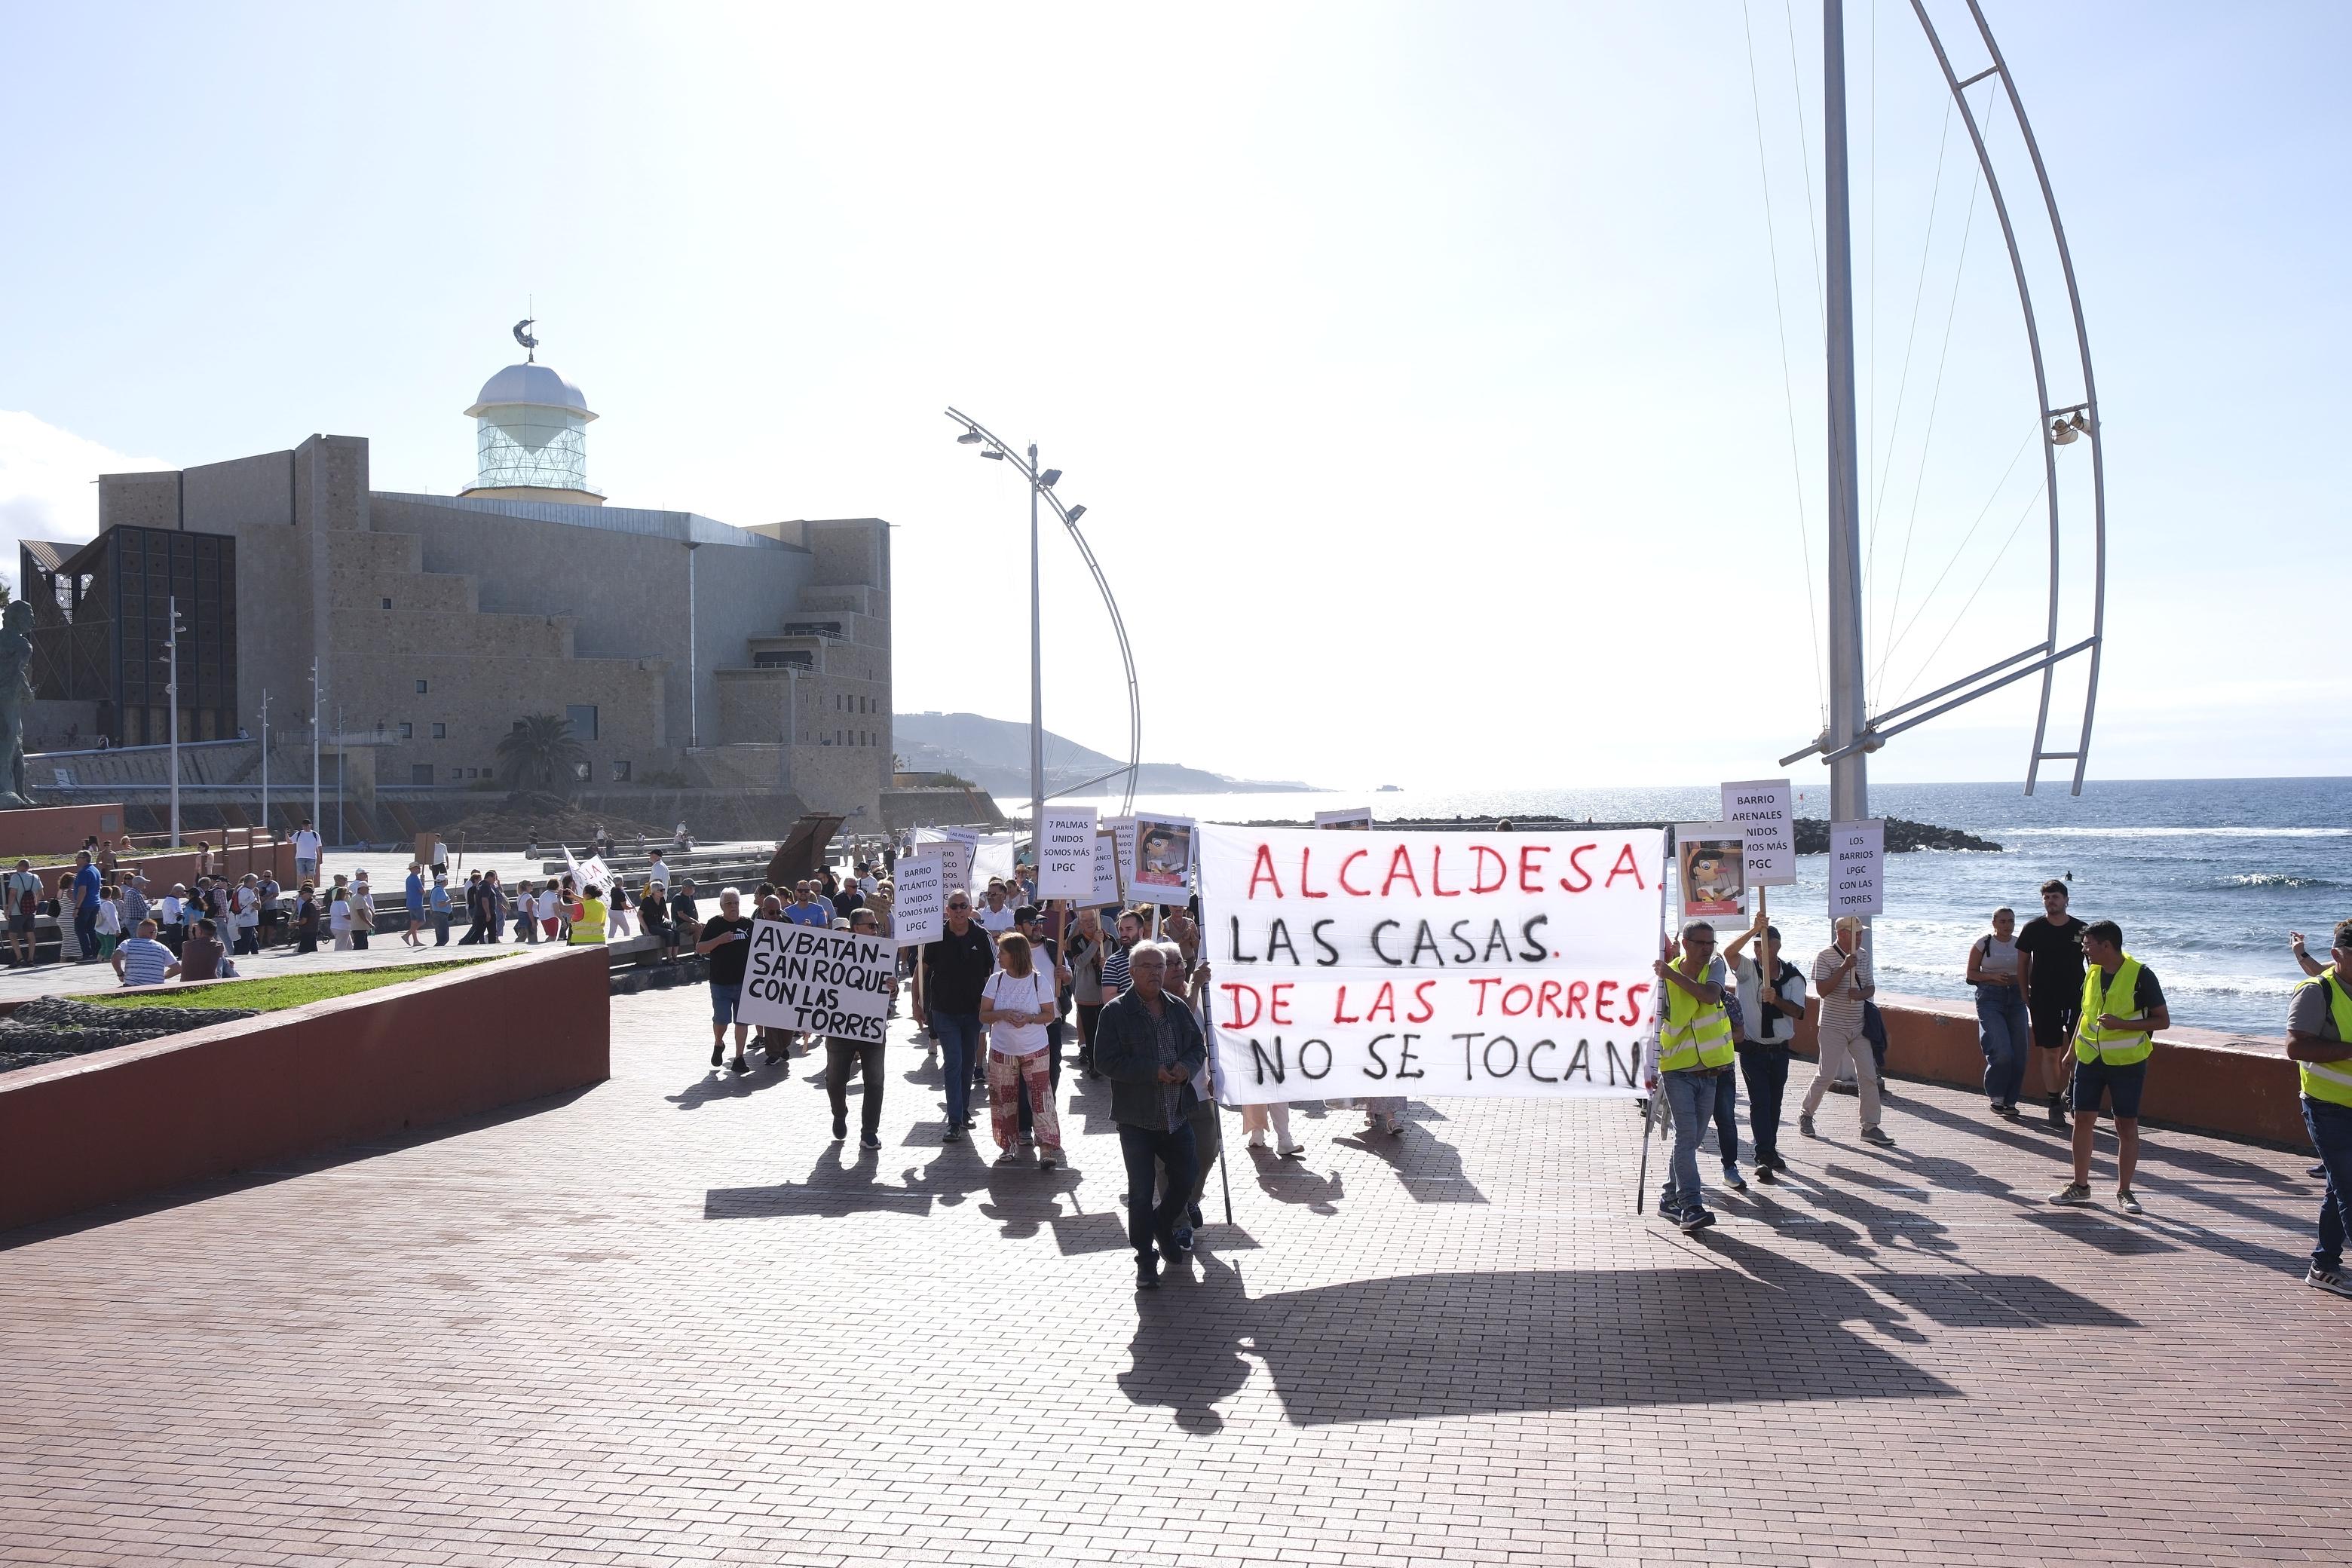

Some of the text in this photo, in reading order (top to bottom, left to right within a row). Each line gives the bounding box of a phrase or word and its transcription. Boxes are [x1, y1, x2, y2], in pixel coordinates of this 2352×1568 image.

[1738, 795, 1775, 805] BARRIO
[1732, 810, 1782, 821] ARENALES
[1049, 820, 1089, 829] 7 PALMAS
[1746, 827, 1778, 837] NIDOS
[1052, 835, 1083, 843] UNIDOS
[1849, 837, 1864, 845] LOS
[1073, 847, 1090, 856] MÁS
[1767, 841, 1787, 851] MÁS
[1839, 850, 1873, 861] BARRIOS
[1052, 862, 1076, 871] LPGC
[1749, 859, 1772, 869] PGC
[1846, 865, 1866, 874] LPGC
[905, 866, 932, 877] BARRIO
[1098, 873, 1113, 881] MÁS
[899, 879, 938, 892] ATLÁNTICO
[1839, 879, 1873, 890] CON LAS
[905, 893, 933, 905] UNIDOS
[1839, 894, 1872, 905] TORRES
[898, 905, 939, 918] SOMOS MÁS
[906, 920, 927, 932] LPGC
[1230, 914, 1340, 966] LAS
[752, 953, 893, 994] SAN ROQUE
[749, 978, 839, 1010] CON LAS
[1220, 982, 1295, 1030] DE
[1334, 980, 1437, 1024] LAS
[794, 1006, 884, 1040] TORRES
[1249, 1034, 1334, 1086] NO
[1362, 1033, 1425, 1080] SE
